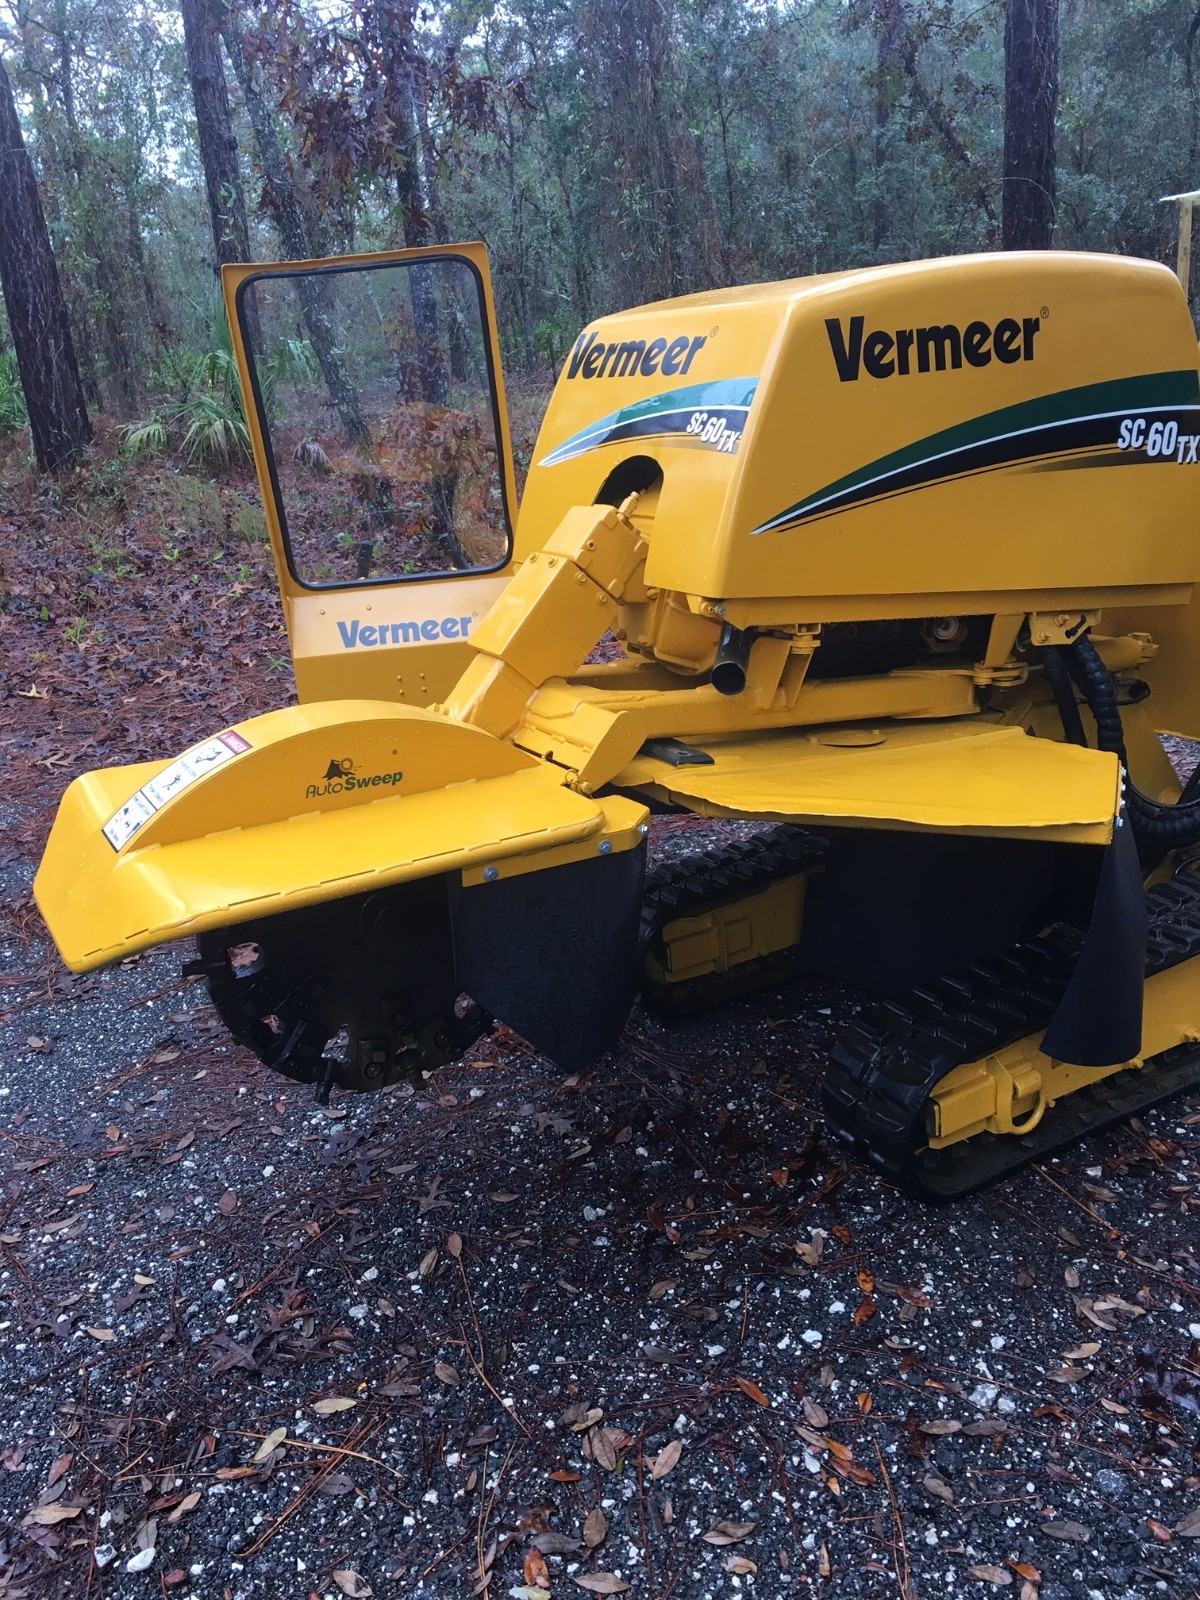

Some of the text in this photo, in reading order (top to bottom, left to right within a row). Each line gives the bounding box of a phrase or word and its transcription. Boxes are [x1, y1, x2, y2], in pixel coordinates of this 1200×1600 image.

[567, 331, 707, 379] Vermeer
[825, 315, 1041, 382] Vermeer
[336, 616, 472, 648] Vermeer
